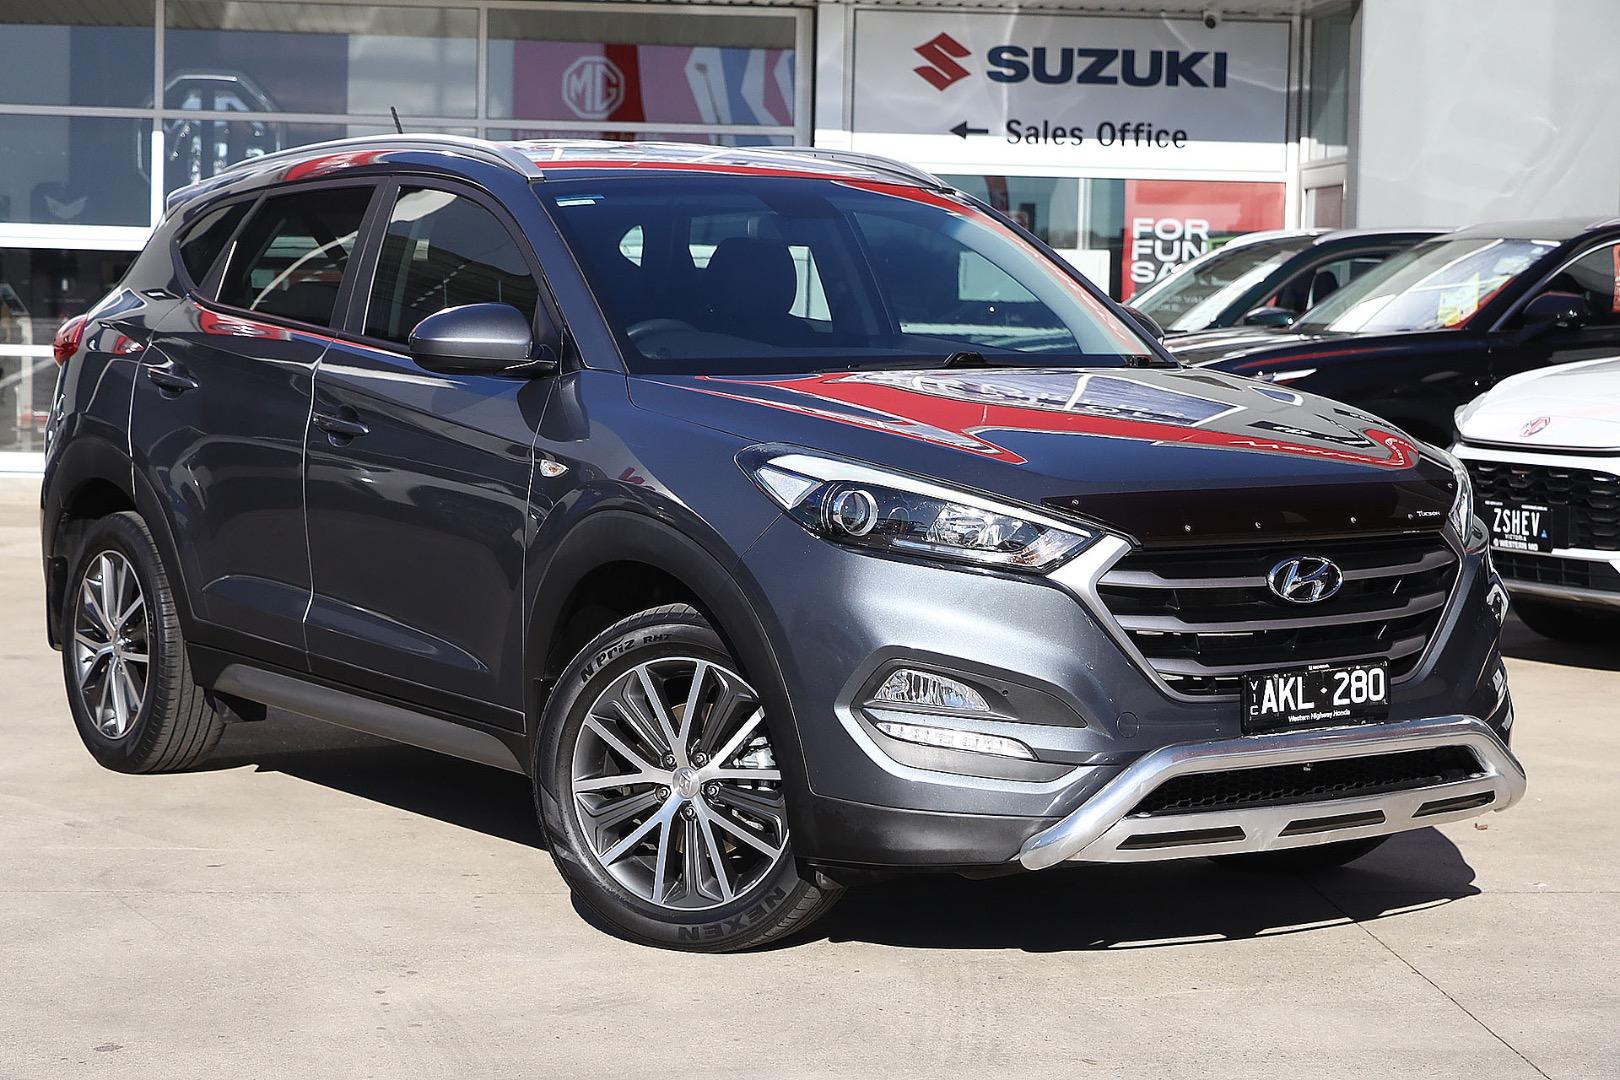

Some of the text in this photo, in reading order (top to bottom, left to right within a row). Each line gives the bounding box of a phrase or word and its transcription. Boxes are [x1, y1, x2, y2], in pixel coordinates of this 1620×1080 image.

[986, 45, 1228, 88] SUZUKI
[569, 62, 619, 114] MG
[1006, 119, 1188, 148] Sales Office
[1132, 218, 1209, 240] FOR
[1131, 239, 1208, 262] FUN
[1493, 507, 1540, 537] ZSHEV
[1250, 680, 1259, 716] VIC
[1261, 668, 1386, 714] AKL 280
[679, 886, 787, 941] NEXEN
